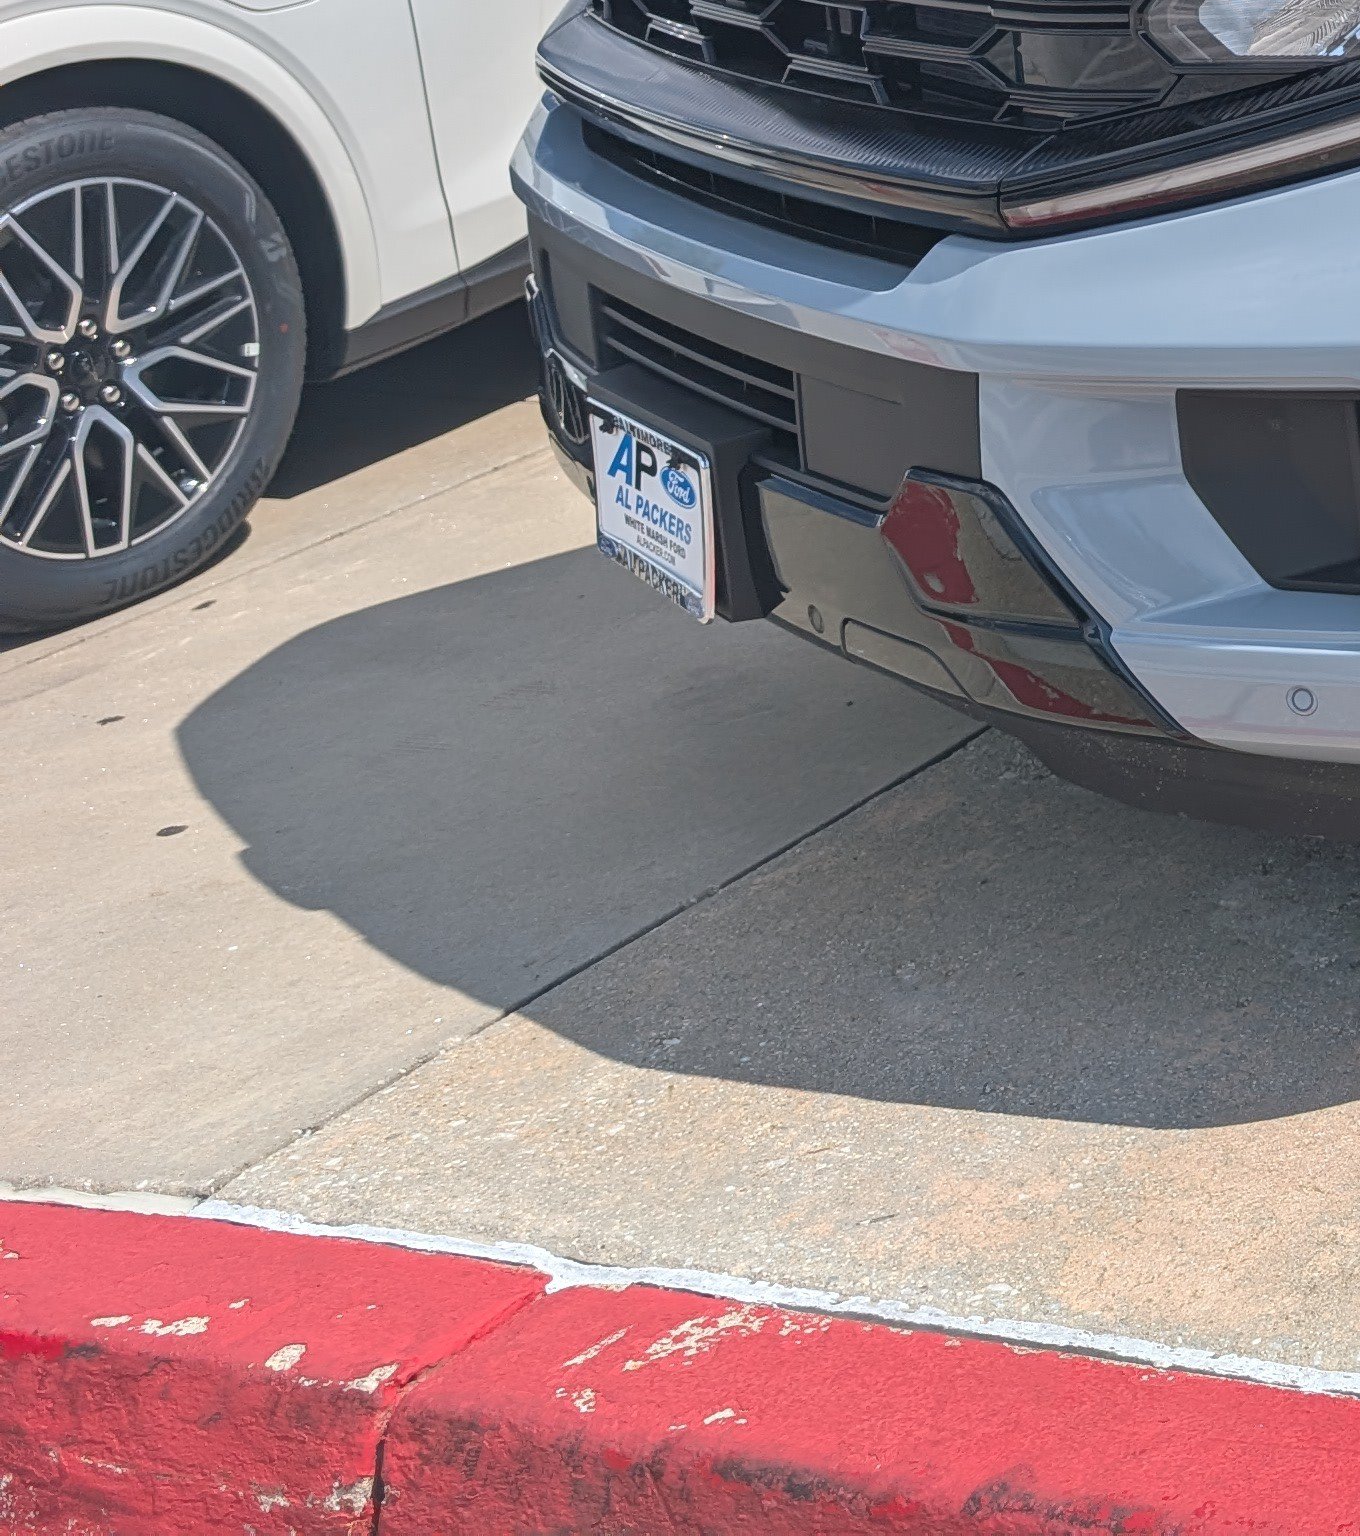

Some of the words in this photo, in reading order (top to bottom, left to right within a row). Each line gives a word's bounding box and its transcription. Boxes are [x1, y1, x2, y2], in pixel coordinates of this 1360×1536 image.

[607, 432, 659, 493] AP
[665, 468, 693, 505] Ford
[615, 484, 632, 511] AL
[635, 494, 692, 545] PACKERS
[624, 512, 645, 535] WHITE
[646, 525, 669, 549] MARSH
[669, 538, 686, 560] FORD
